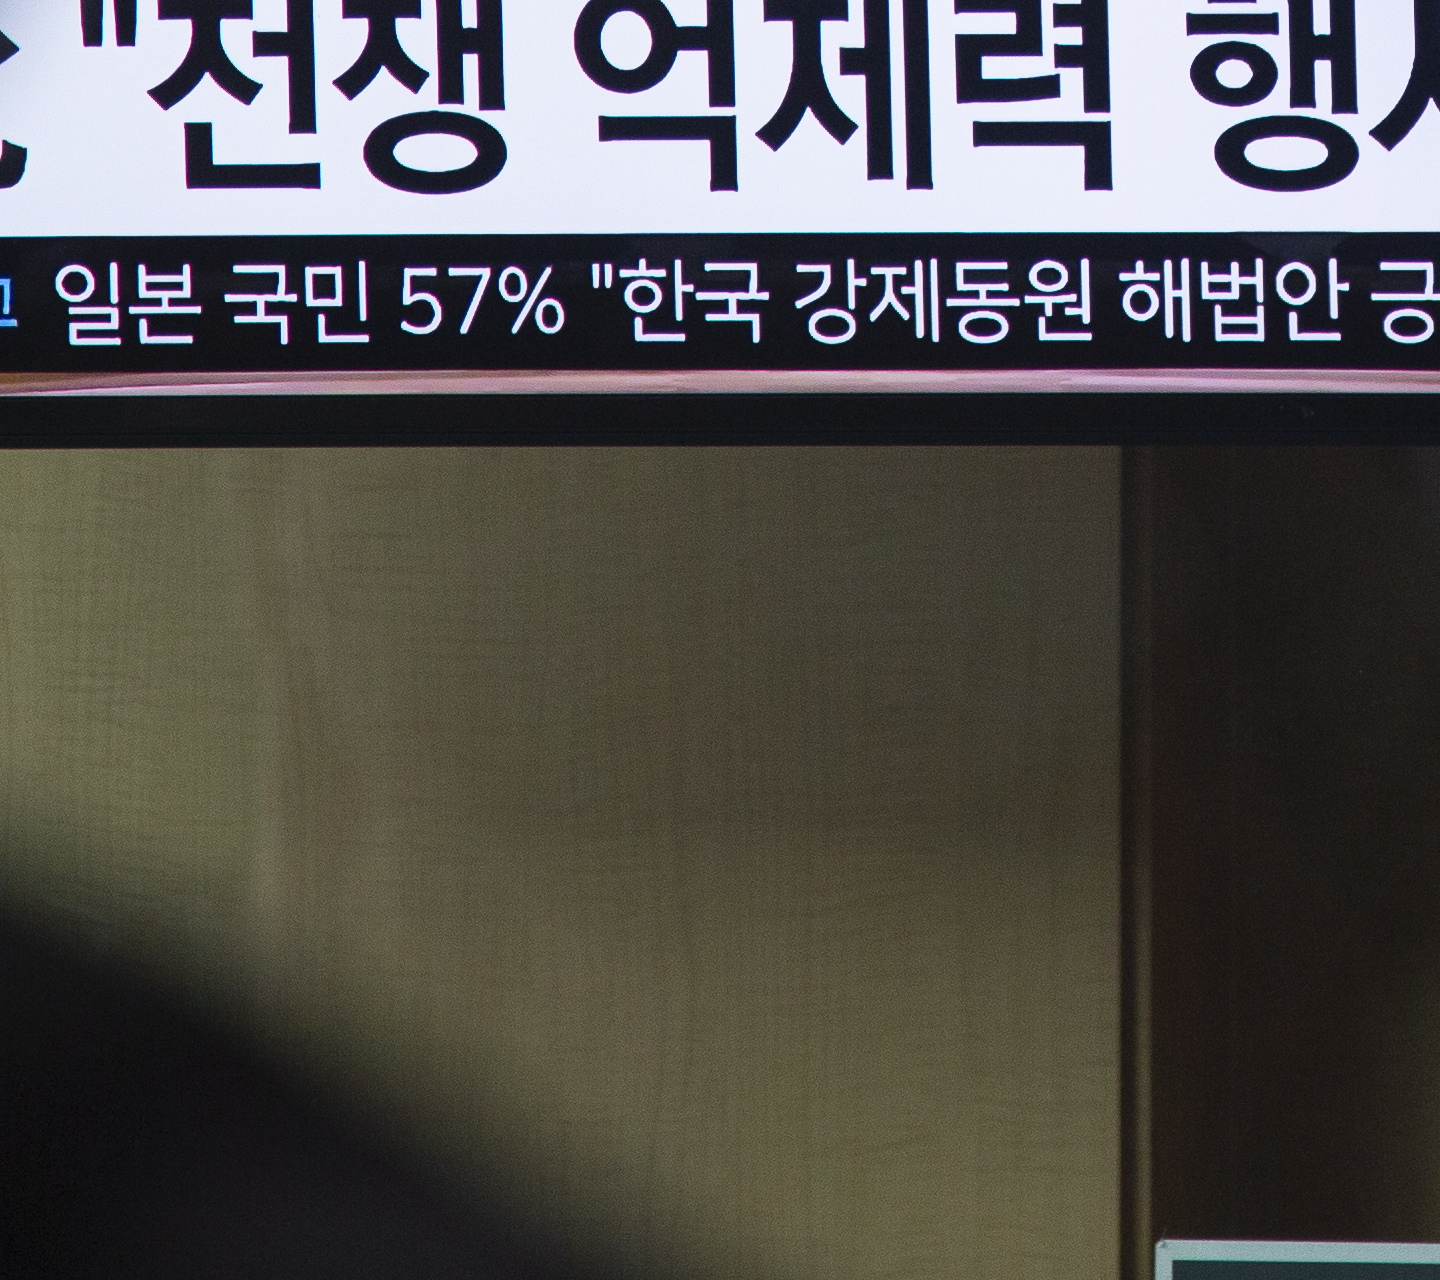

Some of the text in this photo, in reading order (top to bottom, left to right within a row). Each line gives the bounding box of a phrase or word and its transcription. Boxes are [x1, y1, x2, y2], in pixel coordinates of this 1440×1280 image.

[54, 261, 203, 347] 일본
[222, 259, 371, 346] 국민
[399, 265, 566, 336] 57%
[590, 257, 771, 345] "한국
[794, 257, 1094, 346] 강제동원
[1117, 257, 1351, 344] 해법안
